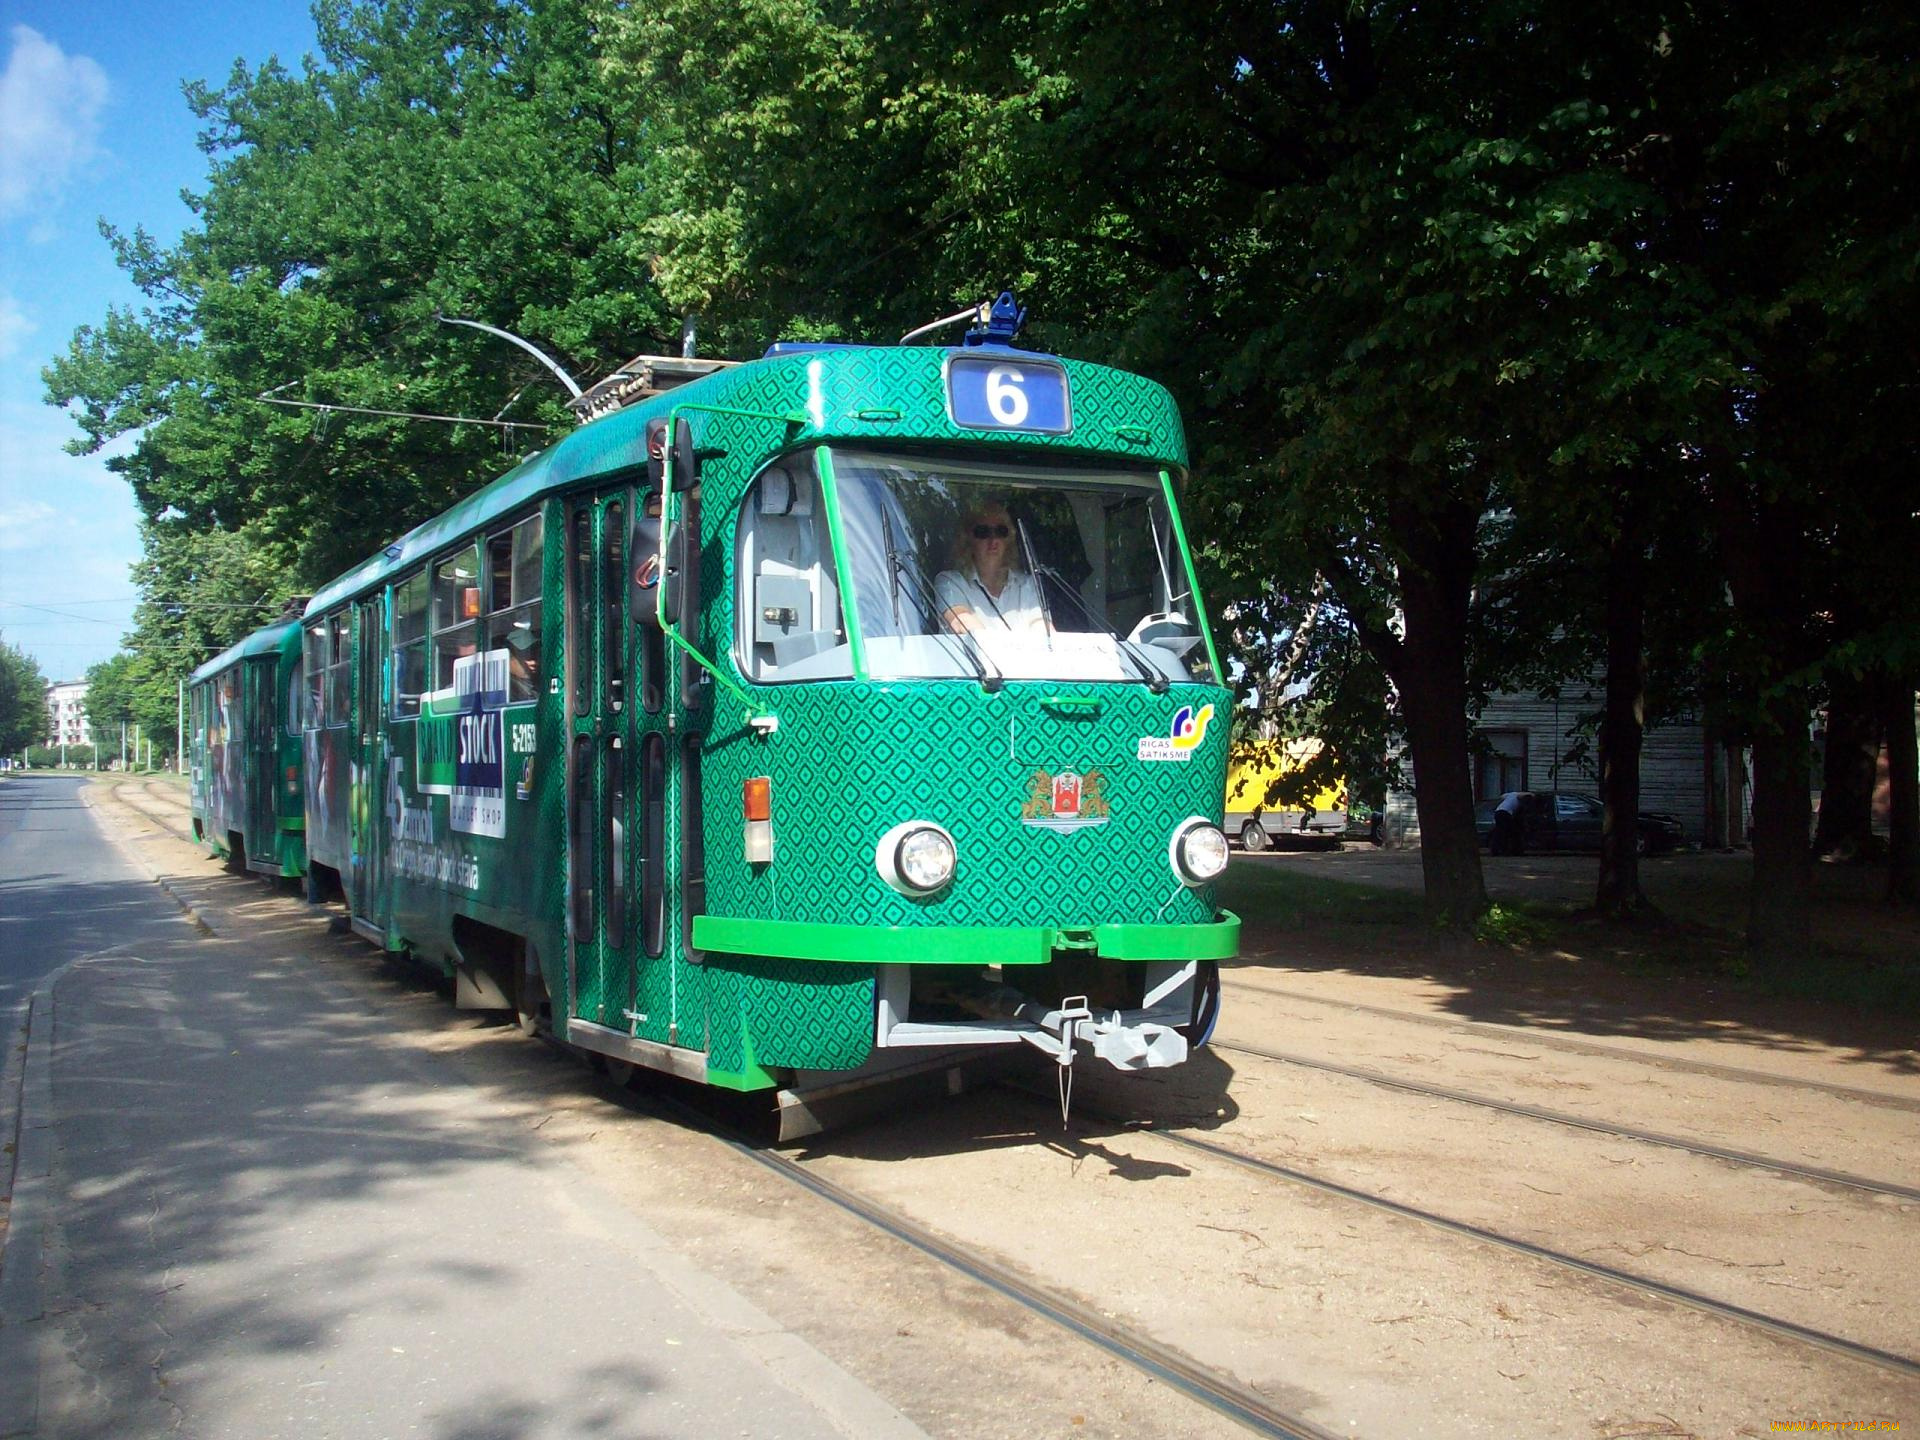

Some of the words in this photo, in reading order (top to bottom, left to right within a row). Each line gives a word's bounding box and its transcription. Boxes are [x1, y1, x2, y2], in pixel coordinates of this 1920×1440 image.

[986, 365, 1028, 426] 6
[420, 718, 452, 764] BRAND
[460, 713, 497, 764] STOCK
[1140, 750, 1188, 759] SATIKSME
[482, 808, 502, 825] SHOP
